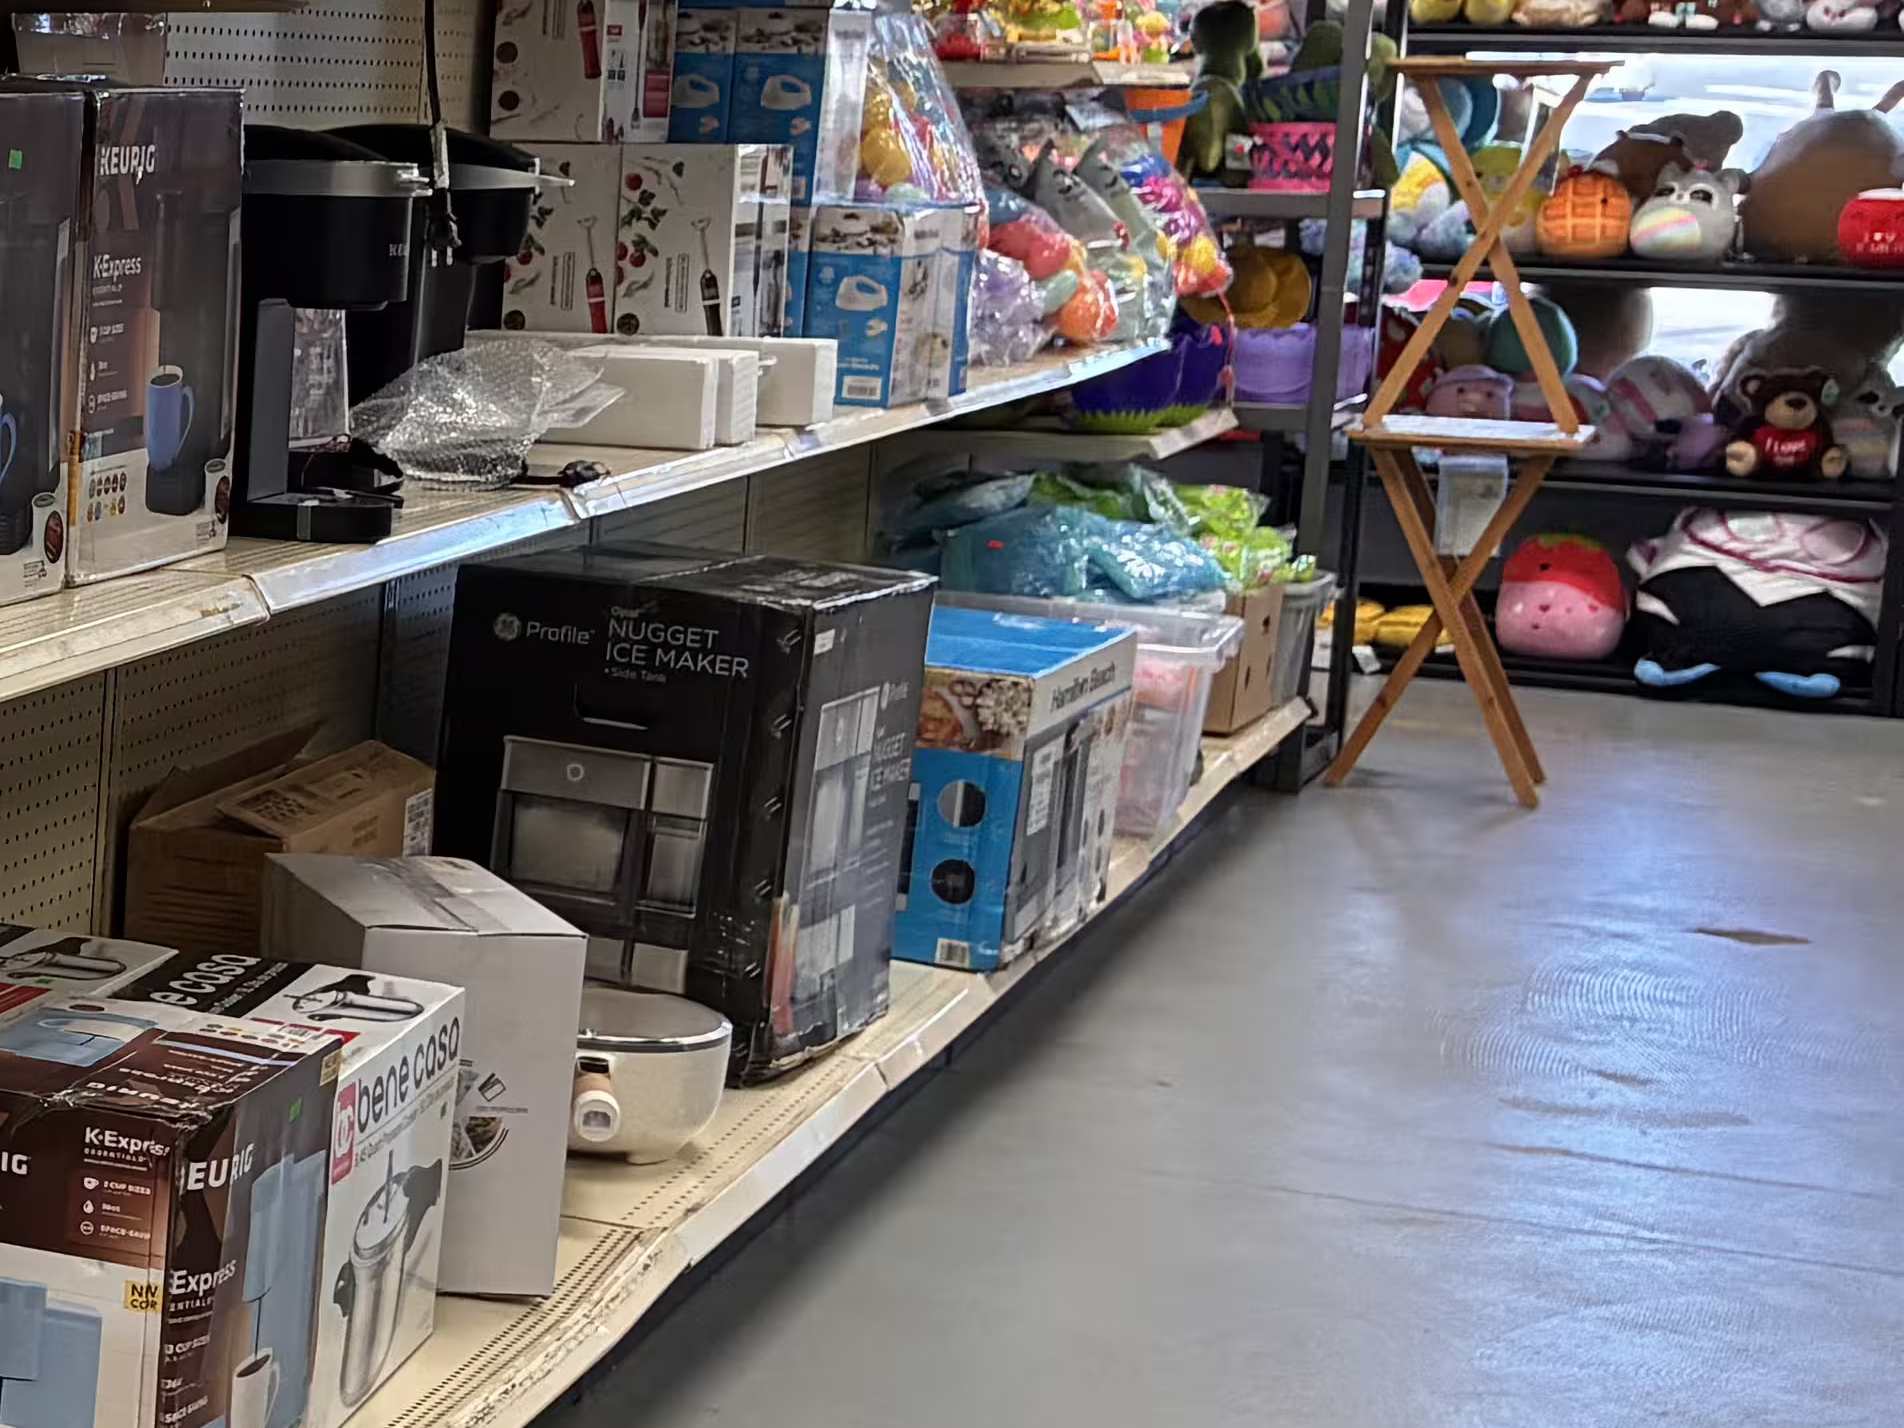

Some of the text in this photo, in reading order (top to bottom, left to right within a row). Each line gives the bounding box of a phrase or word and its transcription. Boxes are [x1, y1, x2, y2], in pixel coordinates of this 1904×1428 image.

[100, 144, 156, 175] KEURIG
[526, 621, 590, 645] Profile
[608, 618, 719, 649] NUGGET
[606, 642, 749, 678] ICE MAKER
[1051, 661, 1116, 713] Hamilton Beach
[177, 953, 262, 995] casa
[357, 1016, 460, 1134] bene casa
